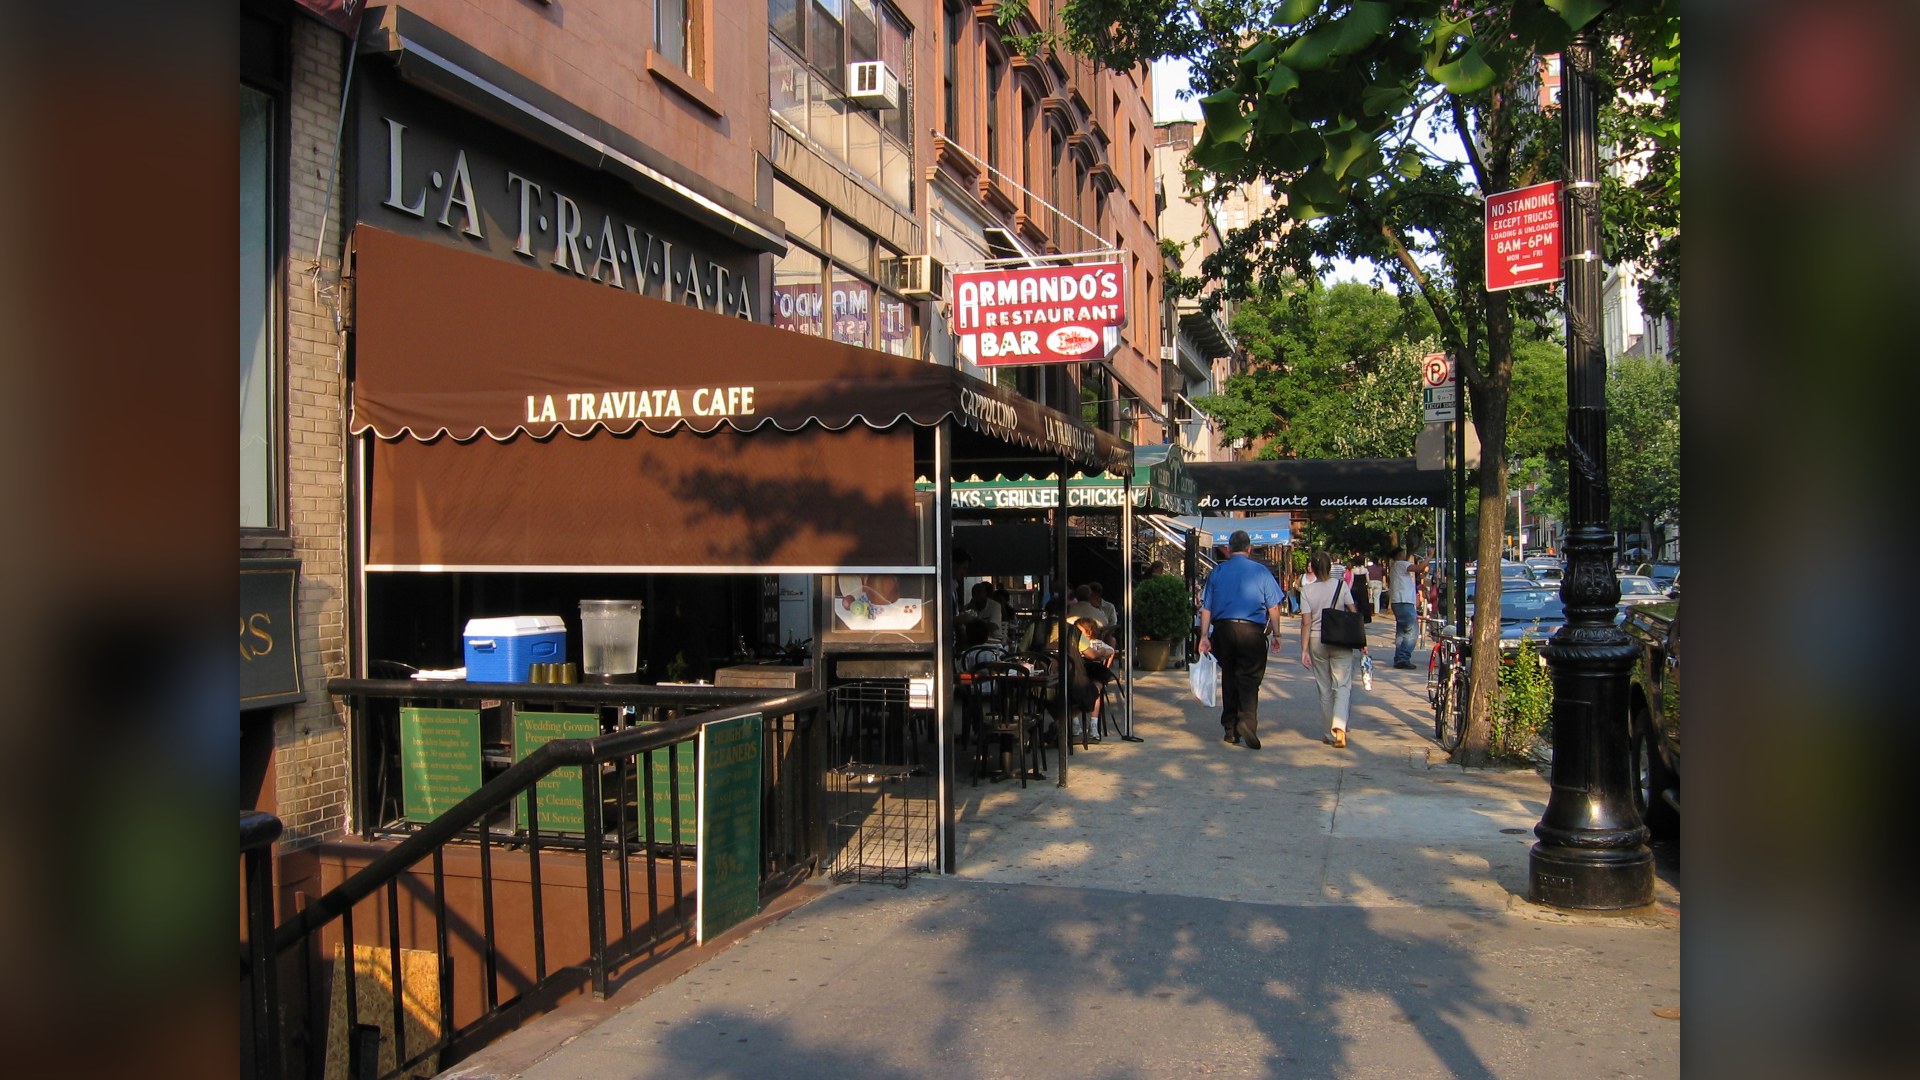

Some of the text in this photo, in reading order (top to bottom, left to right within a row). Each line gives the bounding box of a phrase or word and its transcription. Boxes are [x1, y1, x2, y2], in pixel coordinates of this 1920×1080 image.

[1491, 192, 1555, 218] NO STANDING
[1490, 229, 1517, 241] LOADING
[1524, 220, 1559, 234] UNLOADING
[1493, 209, 1553, 231] EXCEPT TRUCKS
[1497, 232, 1553, 254] 8AM-6PM
[1506, 253, 1520, 262] MON
[1532, 249, 1543, 258] FRI
[959, 269, 1118, 329] ARMANDO'S
[985, 304, 1119, 328] RESTAURANT
[980, 330, 1041, 358] BAR
[527, 387, 755, 423] LA TRAVIATA CAFE
[960, 387, 1018, 430] CAPPUCCINO
[1044, 415, 1056, 443] LA
[998, 489, 1060, 508] GRILLED
[1069, 487, 1139, 508] CHICKEN
[1225, 494, 1309, 507] ristorante
[1320, 495, 1368, 507] cucina
[1371, 495, 1428, 506] classica
[524, 720, 594, 734] Wedding Gowns
[548, 768, 575, 782] ickup
[546, 794, 583, 809] Cleaning
[552, 812, 583, 824] Service
